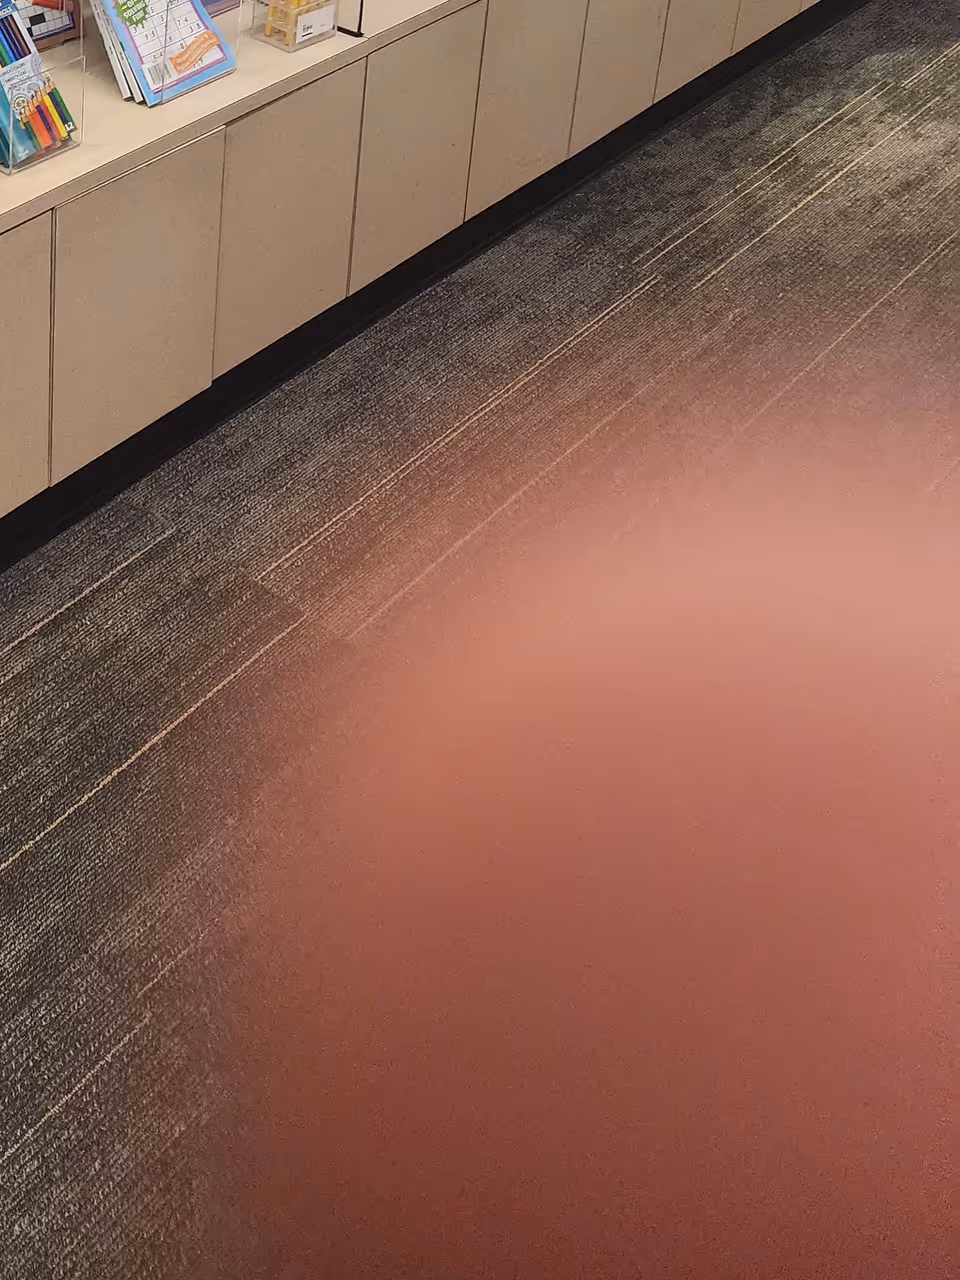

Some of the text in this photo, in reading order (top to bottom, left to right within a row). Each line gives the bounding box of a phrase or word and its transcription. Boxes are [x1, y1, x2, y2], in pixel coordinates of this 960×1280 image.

[123, 1, 145, 19] SOLVING
[132, 10, 144, 23] FUN!
[65, 121, 75, 131] 12
